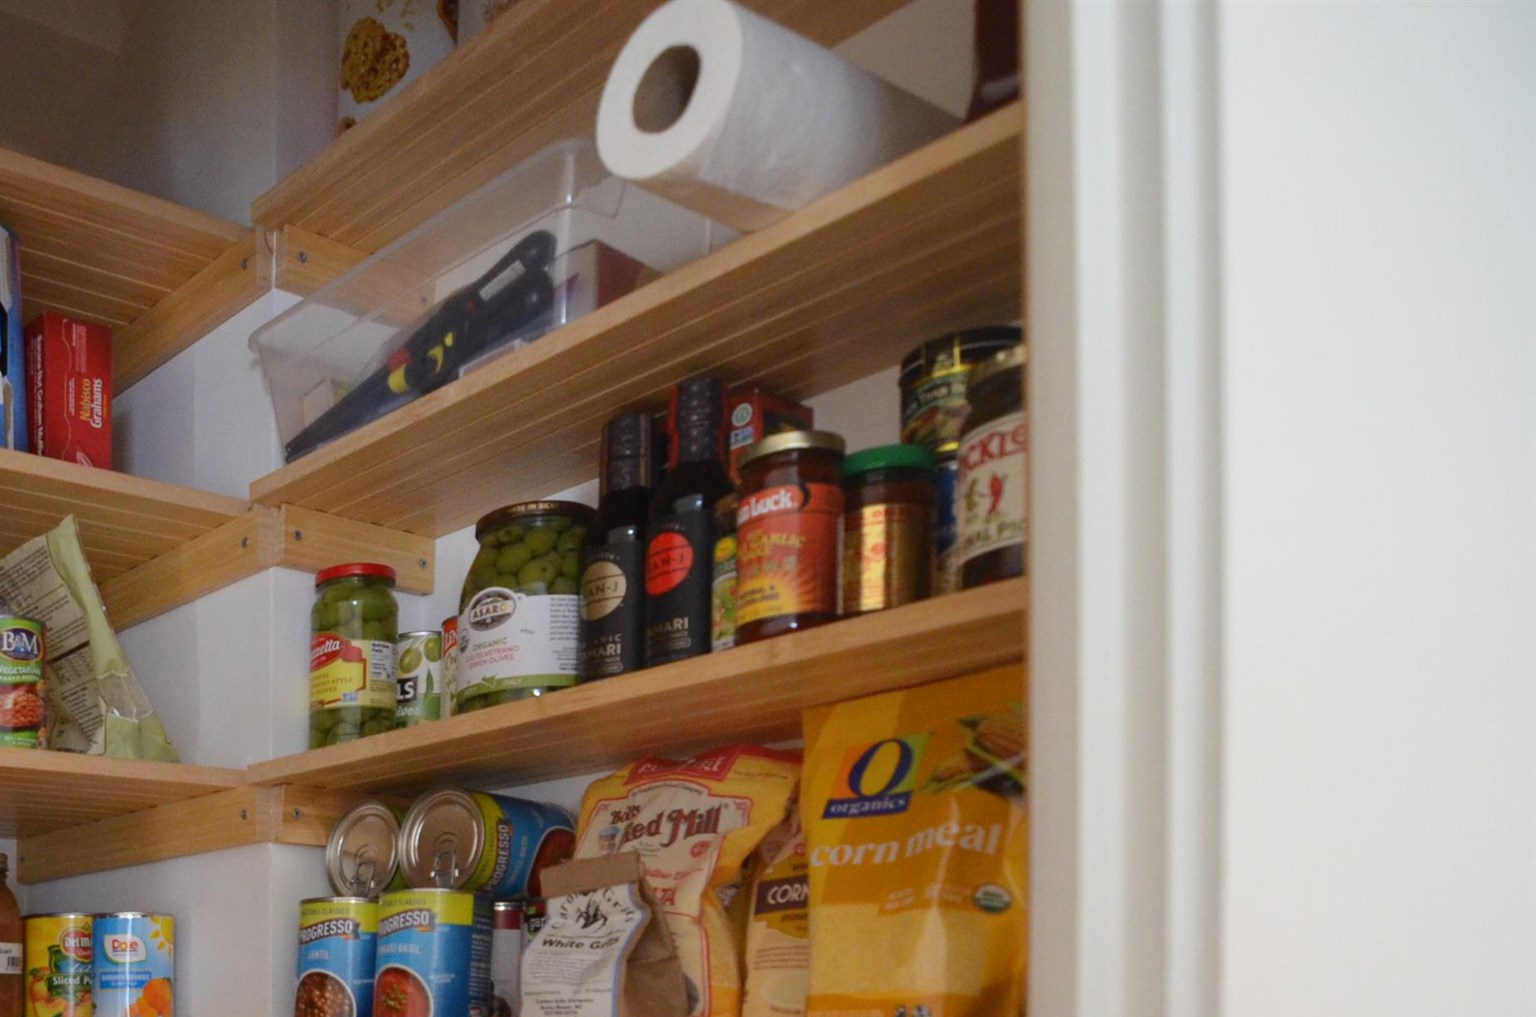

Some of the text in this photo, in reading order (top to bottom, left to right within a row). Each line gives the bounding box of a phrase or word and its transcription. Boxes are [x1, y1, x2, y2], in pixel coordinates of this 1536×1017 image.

[80, 378, 91, 422] Nabisco
[91, 378, 103, 429] Grahams
[751, 489, 794, 514] Luck
[472, 603, 512, 622] ASARO
[0, 630, 41, 655] B&M
[828, 796, 908, 817] organics
[809, 839, 900, 868] corn
[905, 822, 1004, 860] meal
[541, 936, 586, 951] White
[52, 974, 81, 986] Sliced
